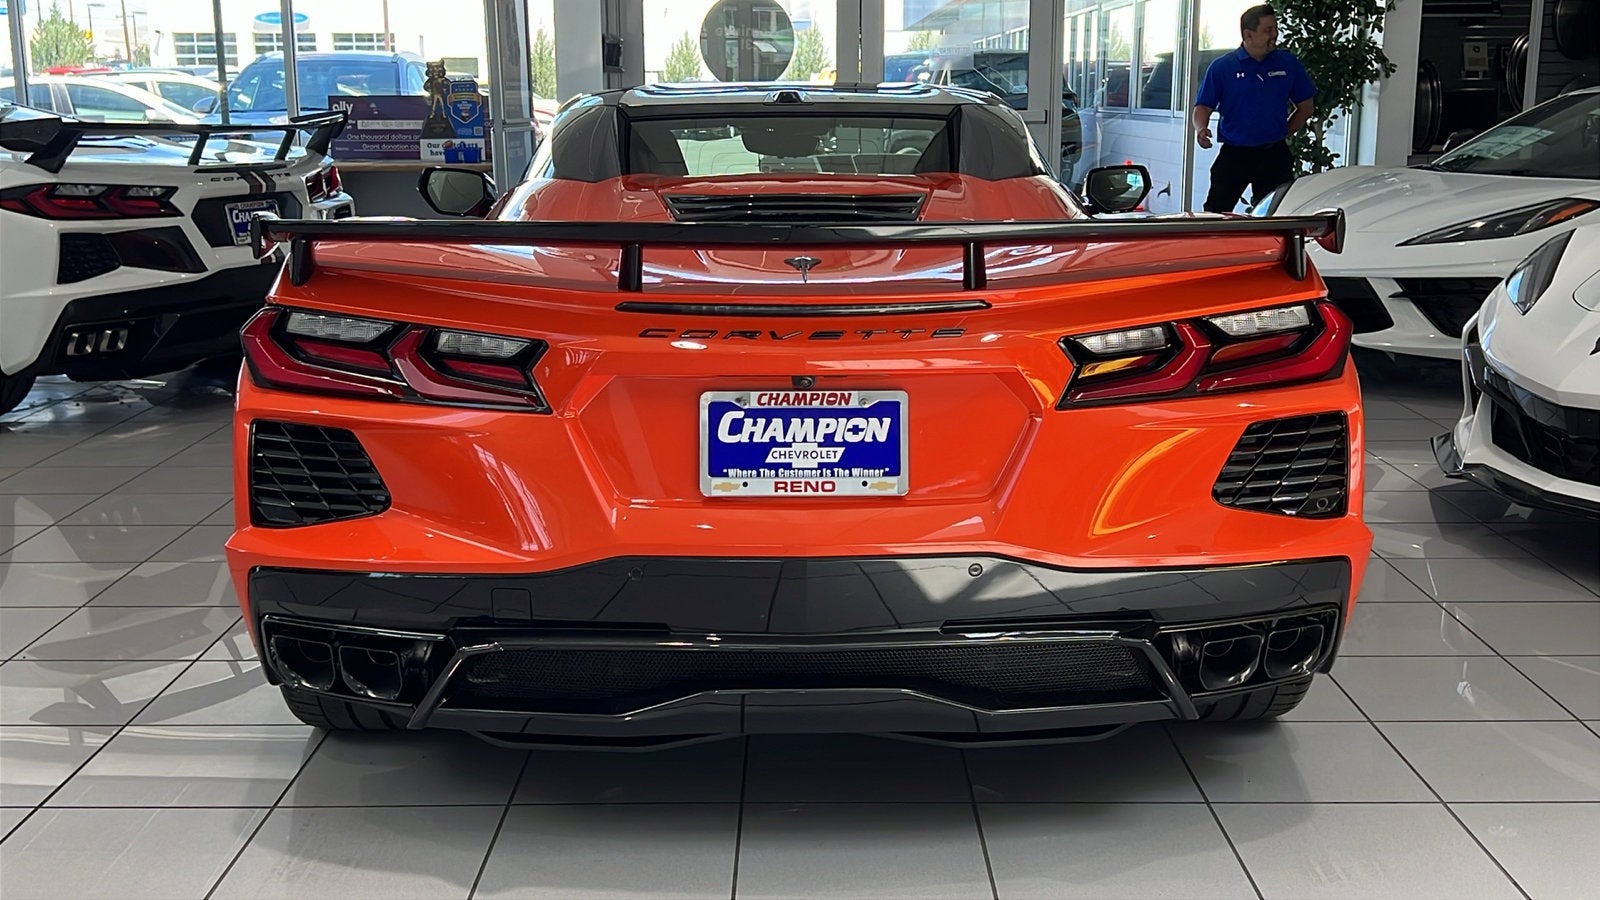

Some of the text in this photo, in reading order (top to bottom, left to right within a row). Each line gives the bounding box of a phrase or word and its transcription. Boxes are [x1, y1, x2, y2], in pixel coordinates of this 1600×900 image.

[332, 101, 353, 115] ally
[638, 328, 967, 340] CORVETTE
[757, 392, 852, 406] CHAMPION
[717, 411, 891, 443] CHAMPION
[771, 450, 838, 460] CHEVROLET
[760, 468, 775, 478] The
[778, 468, 821, 478] Customer
[823, 468, 832, 478] Is
[834, 468, 850, 477] The
[774, 480, 836, 493] RENO
